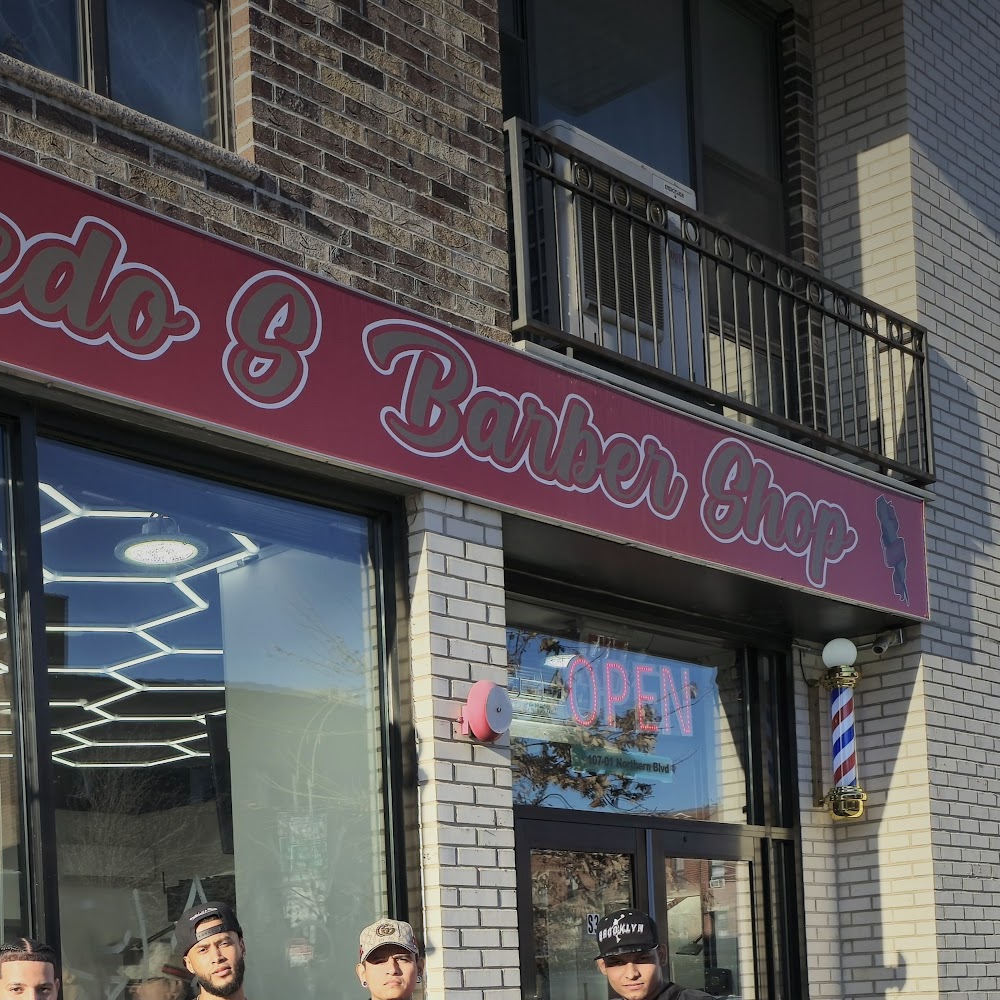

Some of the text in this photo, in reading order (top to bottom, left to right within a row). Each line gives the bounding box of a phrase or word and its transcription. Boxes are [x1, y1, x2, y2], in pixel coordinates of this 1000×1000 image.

[221, 270, 322, 409] S
[361, 318, 688, 520] Barber
[700, 437, 858, 588] Shop
[567, 654, 693, 736] OPEN
[616, 758, 651, 771] Northern
[653, 762, 669, 773] Blvd
[598, 923, 645, 942] BROOKLYN
